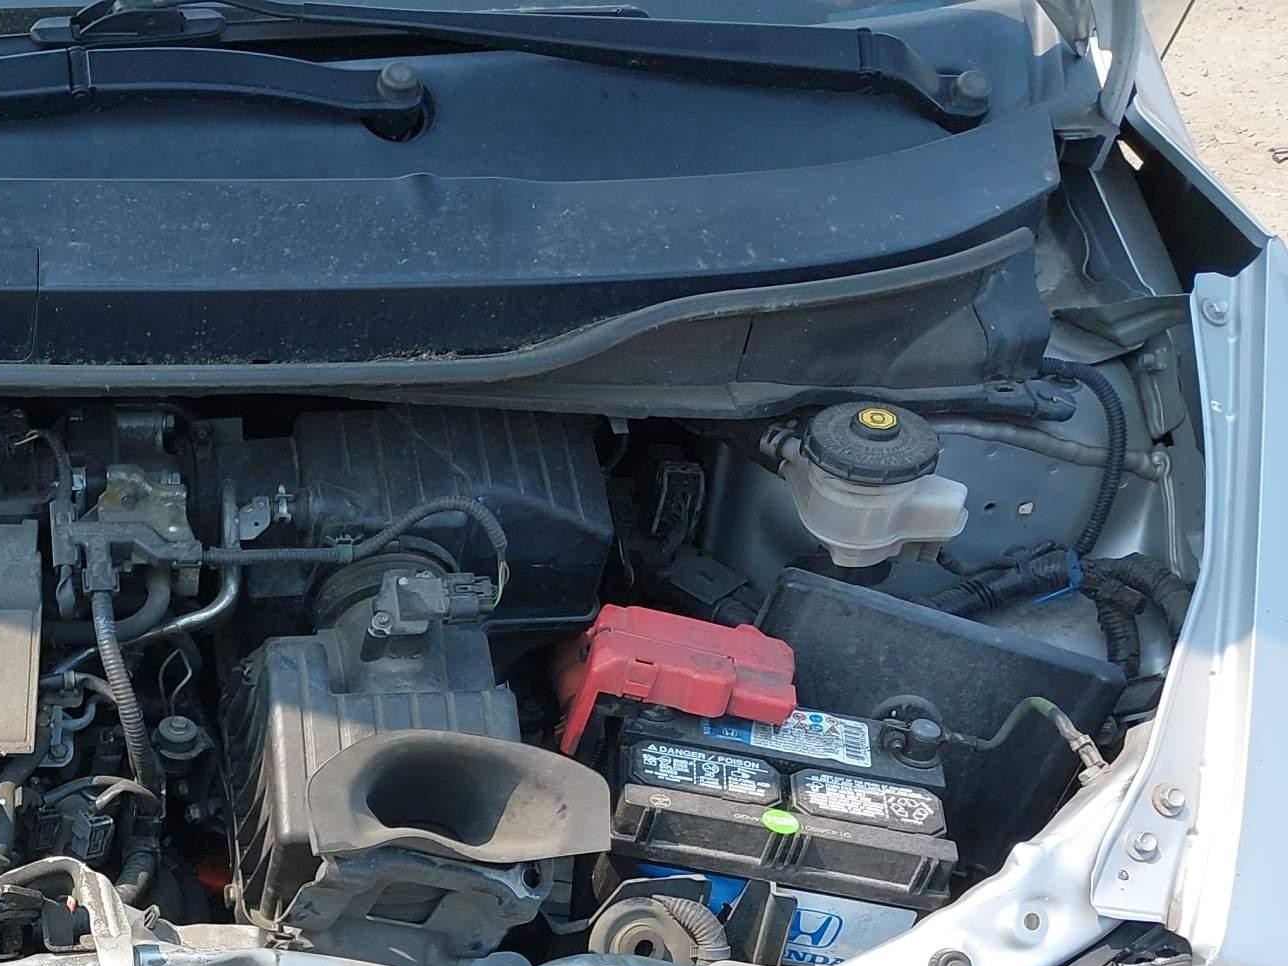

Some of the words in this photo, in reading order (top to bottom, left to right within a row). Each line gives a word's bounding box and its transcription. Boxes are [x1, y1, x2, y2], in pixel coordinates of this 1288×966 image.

[659, 744, 706, 760] DANGER
[717, 756, 761, 770] POISON
[784, 949, 845, 966] NDA
